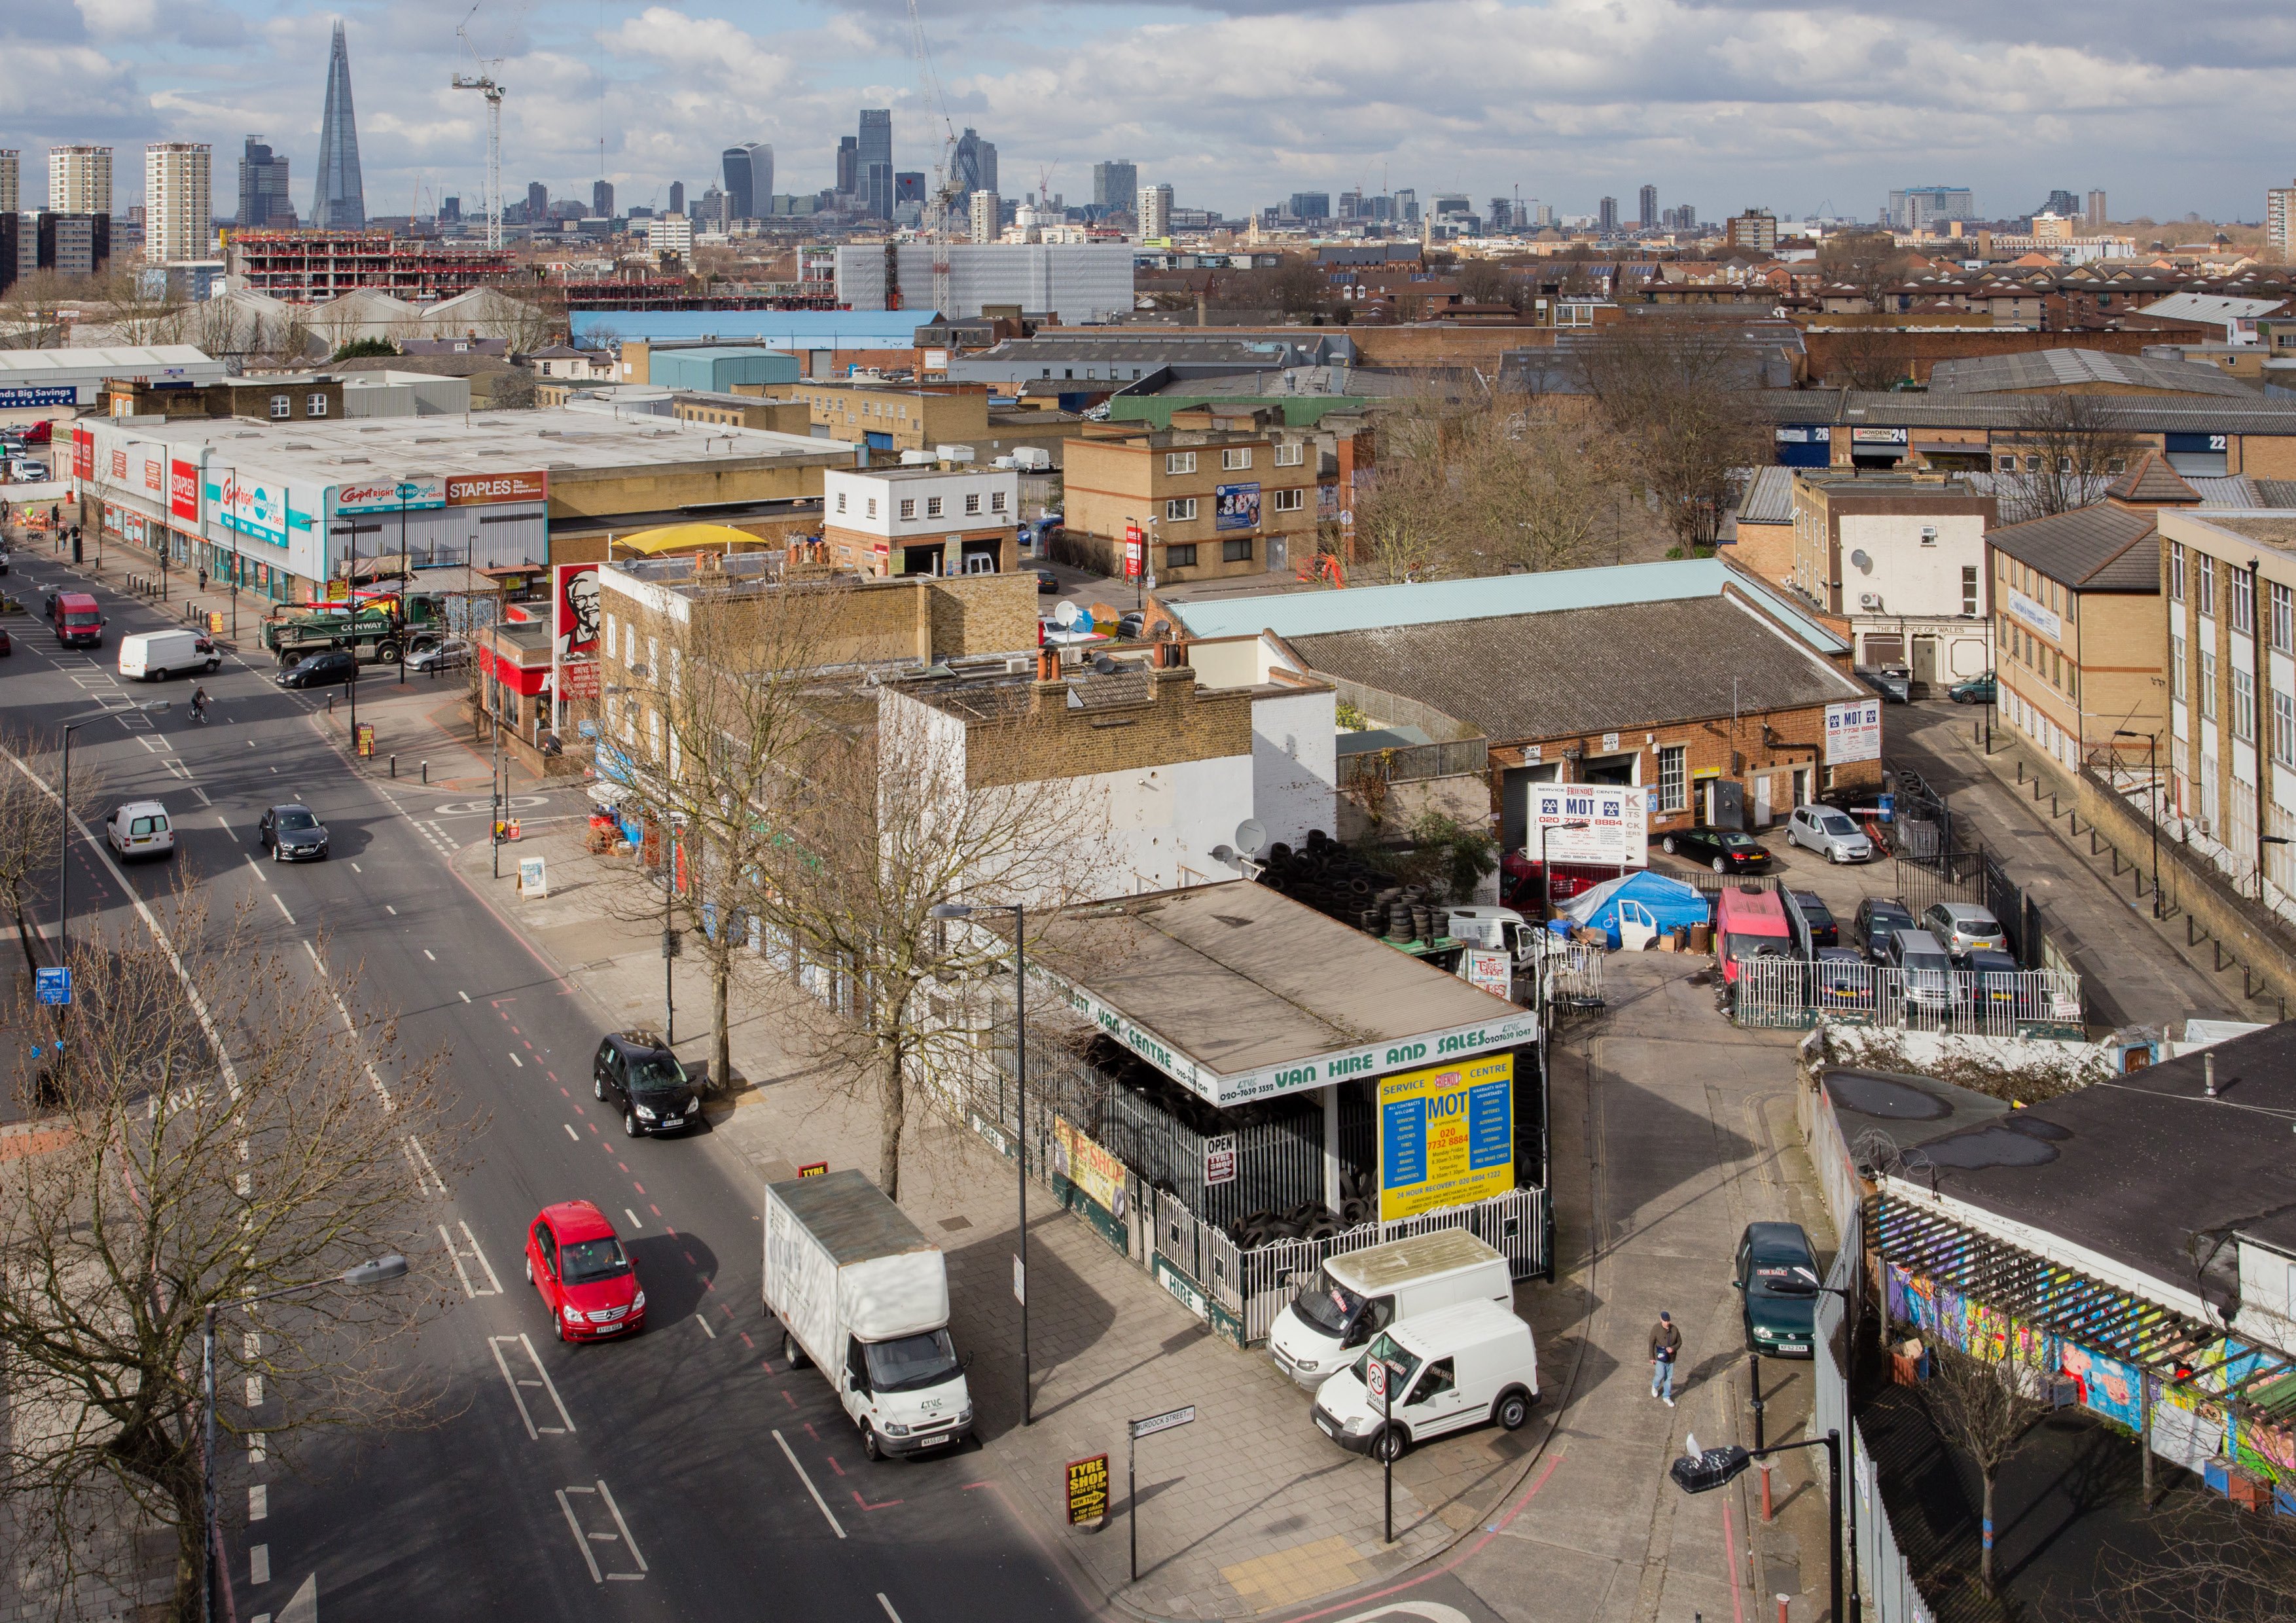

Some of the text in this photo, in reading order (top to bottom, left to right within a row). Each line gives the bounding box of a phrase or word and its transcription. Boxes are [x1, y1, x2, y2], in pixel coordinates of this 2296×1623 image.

[1816, 428, 1829, 441] 26
[1892, 429, 1907, 442] 24
[2210, 436, 2225, 449] 22
[172, 473, 195, 498] STAPLES
[450, 480, 511, 499] STAPLES
[340, 486, 394, 503] Carpet RIGHT
[341, 622, 382, 631] CONWAY
[1844, 711, 1861, 725] MOT
[1567, 787, 1593, 796] FRIENDLY
[1567, 798, 1594, 815] MOT
[1475, 961, 1503, 972] TYRES
[1098, 1008, 1172, 1069] VAN CENTRE
[1275, 1065, 1316, 1088] VAN
[1329, 1054, 1373, 1077] HIRE
[1386, 1043, 1427, 1064] AND
[1437, 1029, 1486, 1054] SALES
[1484, 1033, 1514, 1044] 0207639
[1384, 1079, 1425, 1096] SERVICE
[1470, 1063, 1507, 1077] CENTRE
[1220, 1084, 1274, 1101] 020-7639 3352
[1397, 1100, 1420, 1109] CONTRACTS
[1428, 1091, 1467, 1120] MOT
[1479, 1116, 1503, 1125] ALTERNATORS
[1440, 1128, 1456, 1138] 020
[1208, 1136, 1232, 1153] OPEN
[1427, 1135, 1469, 1150] 7732 8884
[1210, 1153, 1230, 1164] TYRE
[1432, 1147, 1463, 1158] Monday-Friday
[1090, 1145, 1124, 1182] SHOP
[1210, 1160, 1232, 1170] SHOP
[803, 1166, 825, 1177] TYRE
[1426, 1182, 1458, 1192] RECOVERY:
[1487, 1170, 1500, 1179] 1222
[1169, 1274, 1193, 1309] HIRE
[1372, 1371, 1382, 1387] 20
[1441, 1370, 1453, 1381] SALE
[1369, 1391, 1384, 1408] ZONE
[1136, 1416, 1164, 1431] MURDOCK
[1166, 1410, 1187, 1423] STREET
[1069, 1459, 1103, 1478] TYRE
[1069, 1471, 1107, 1491] SHOP
[1071, 1487, 1086, 1496] 07424
[1085, 1493, 1101, 1503] TYRES
[1088, 1509, 1103, 1518] TYRES
[1089, 1503, 1104, 1512] GRADE
